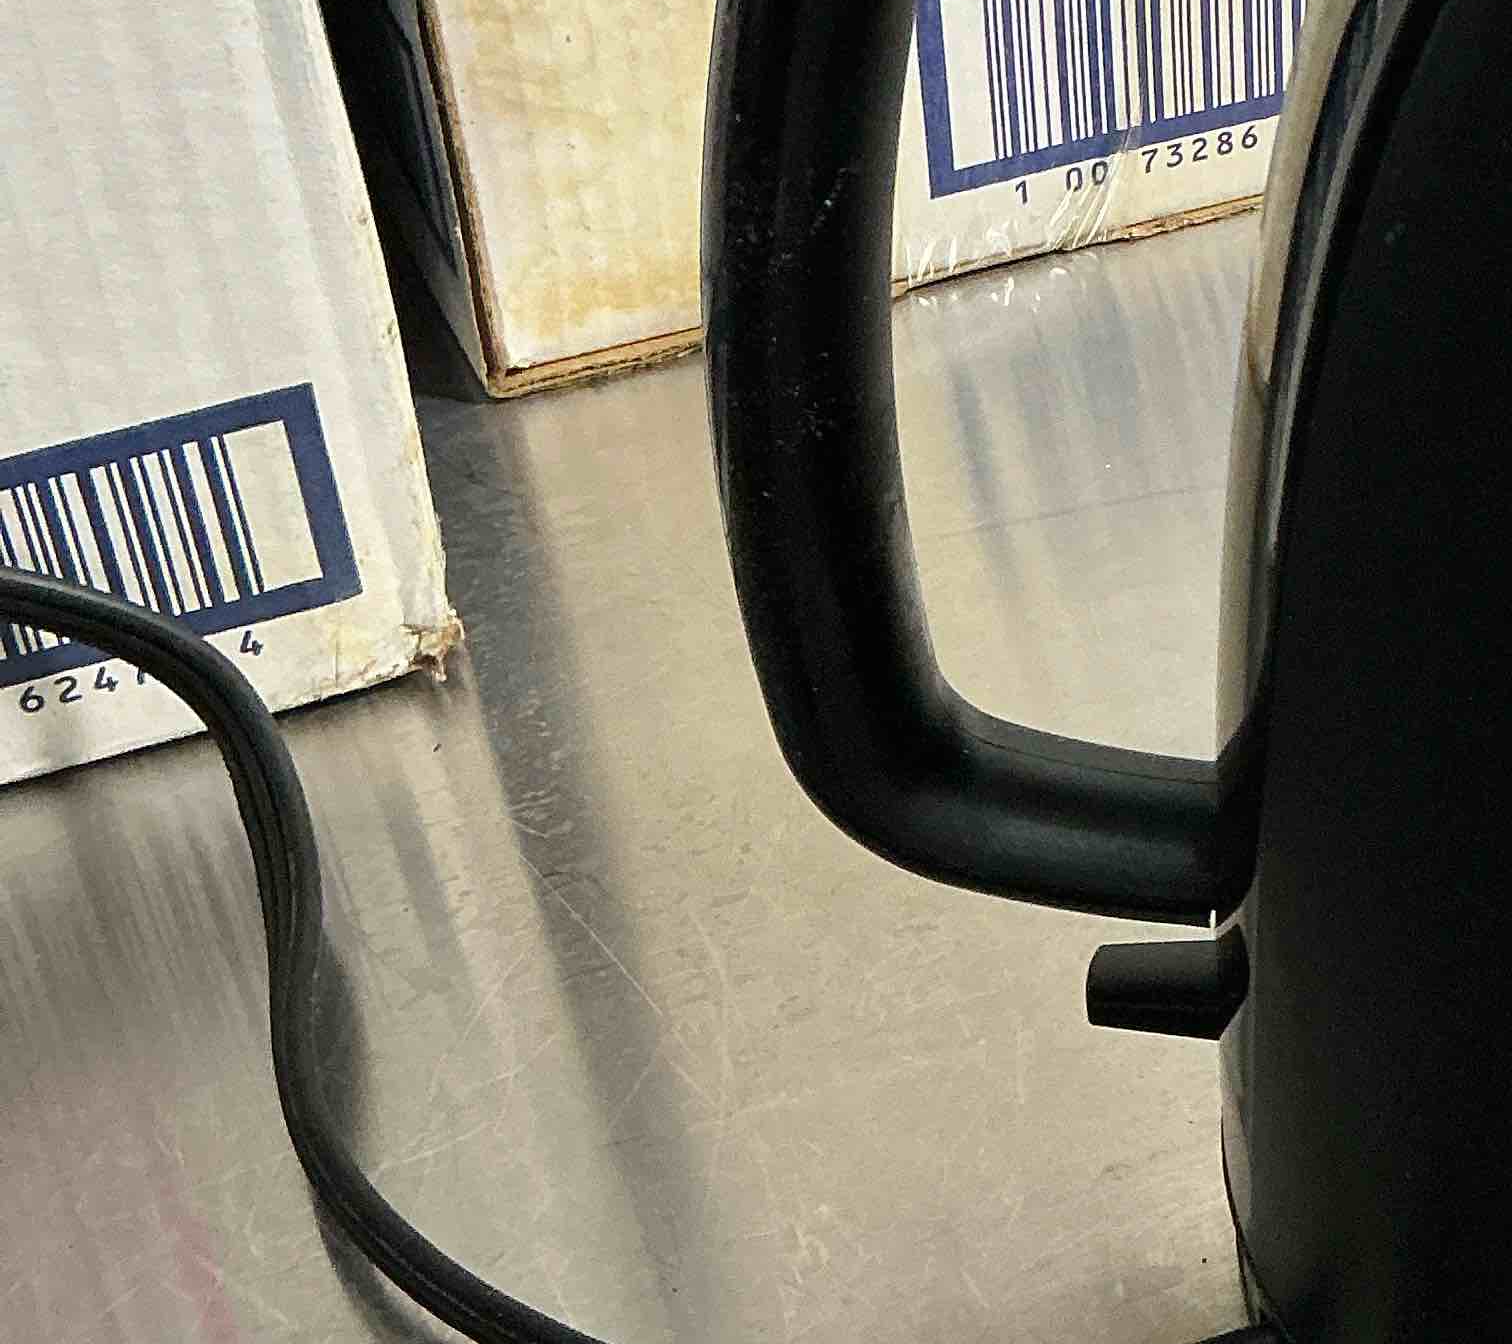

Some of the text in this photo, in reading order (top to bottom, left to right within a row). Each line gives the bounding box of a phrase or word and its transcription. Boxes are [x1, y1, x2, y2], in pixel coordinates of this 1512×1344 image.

[1014, 125, 1260, 206] 1 00 73286
[239, 629, 264, 657] 4
